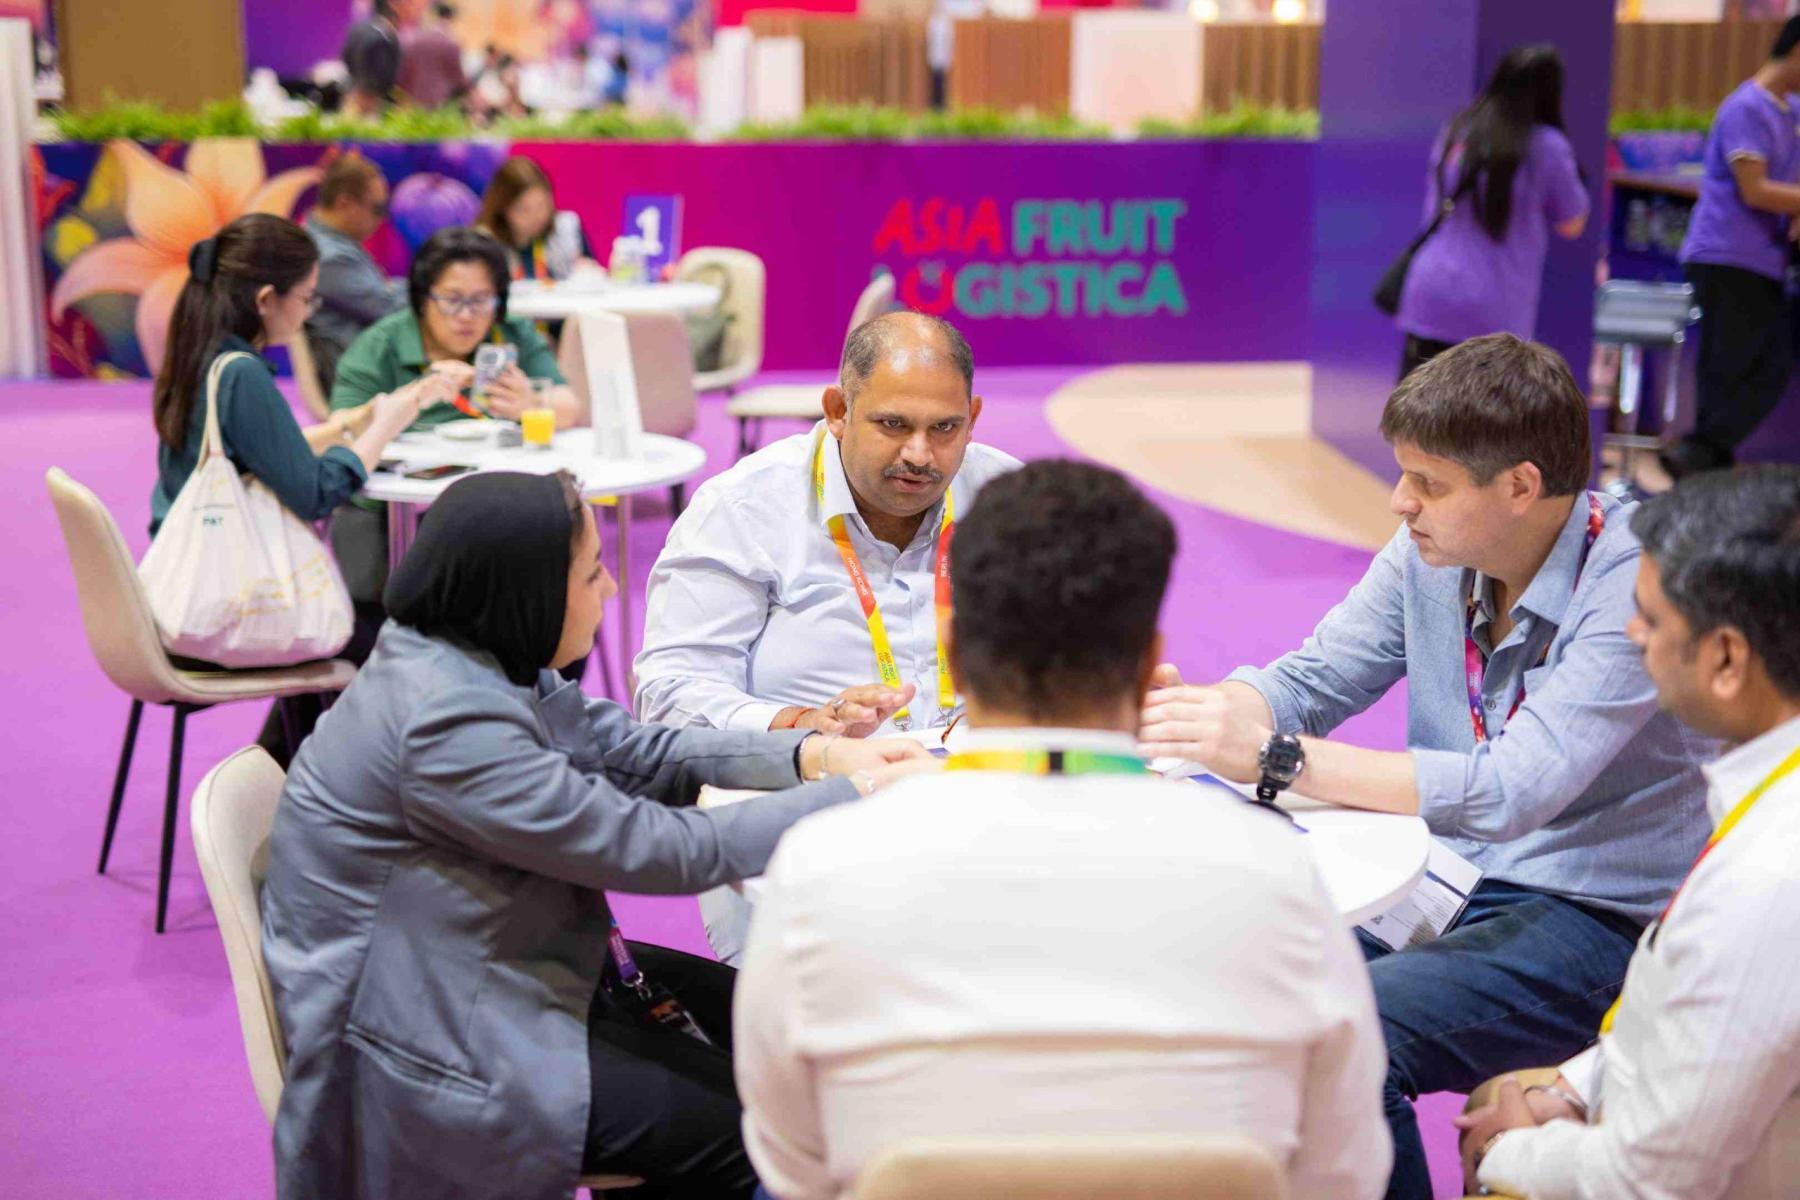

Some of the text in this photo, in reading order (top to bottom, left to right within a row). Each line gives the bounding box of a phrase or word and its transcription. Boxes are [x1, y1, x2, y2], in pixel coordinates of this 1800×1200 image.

[636, 206, 662, 255] 1
[873, 198, 1186, 255] ASIA FRUIT
